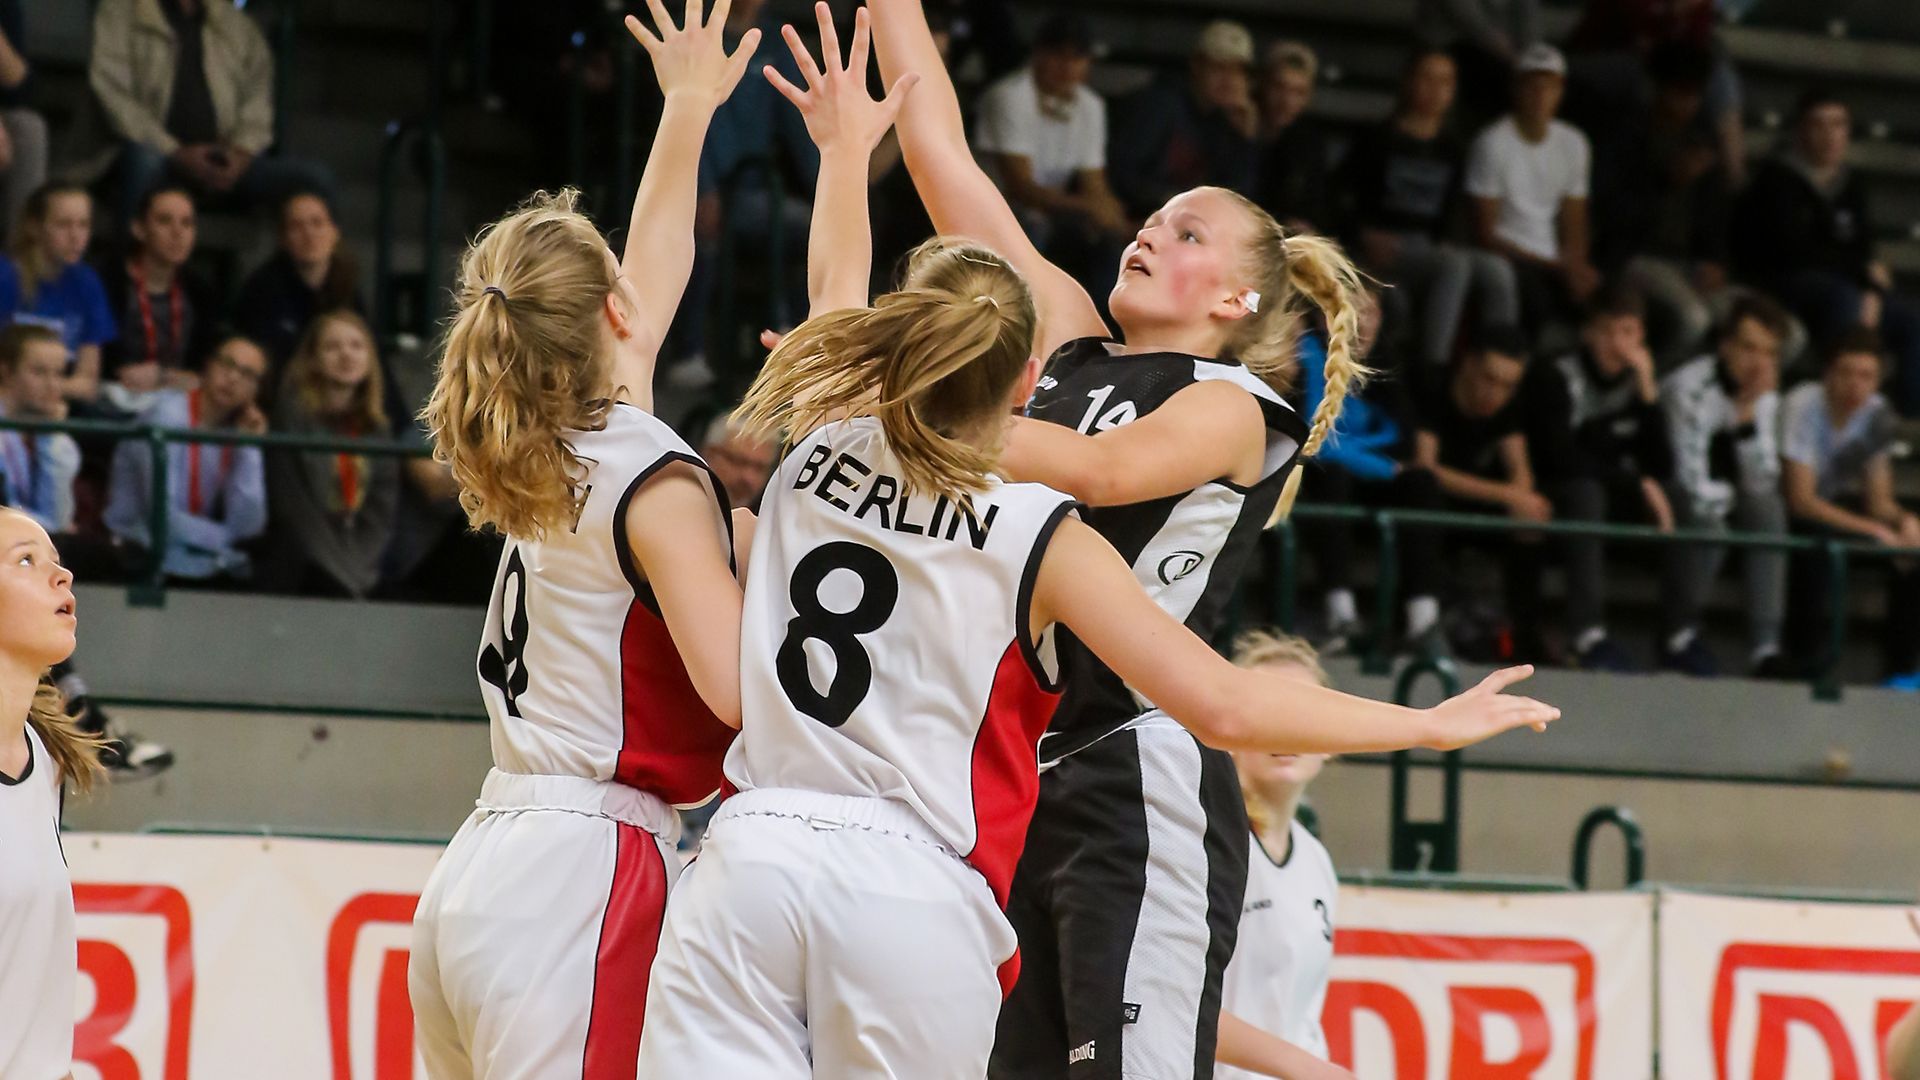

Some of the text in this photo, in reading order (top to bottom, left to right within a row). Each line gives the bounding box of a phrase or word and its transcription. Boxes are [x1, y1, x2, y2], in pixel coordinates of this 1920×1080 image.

[792, 444, 1000, 551] BERLIN
[478, 545, 529, 718] 9
[775, 541, 899, 728] 8
